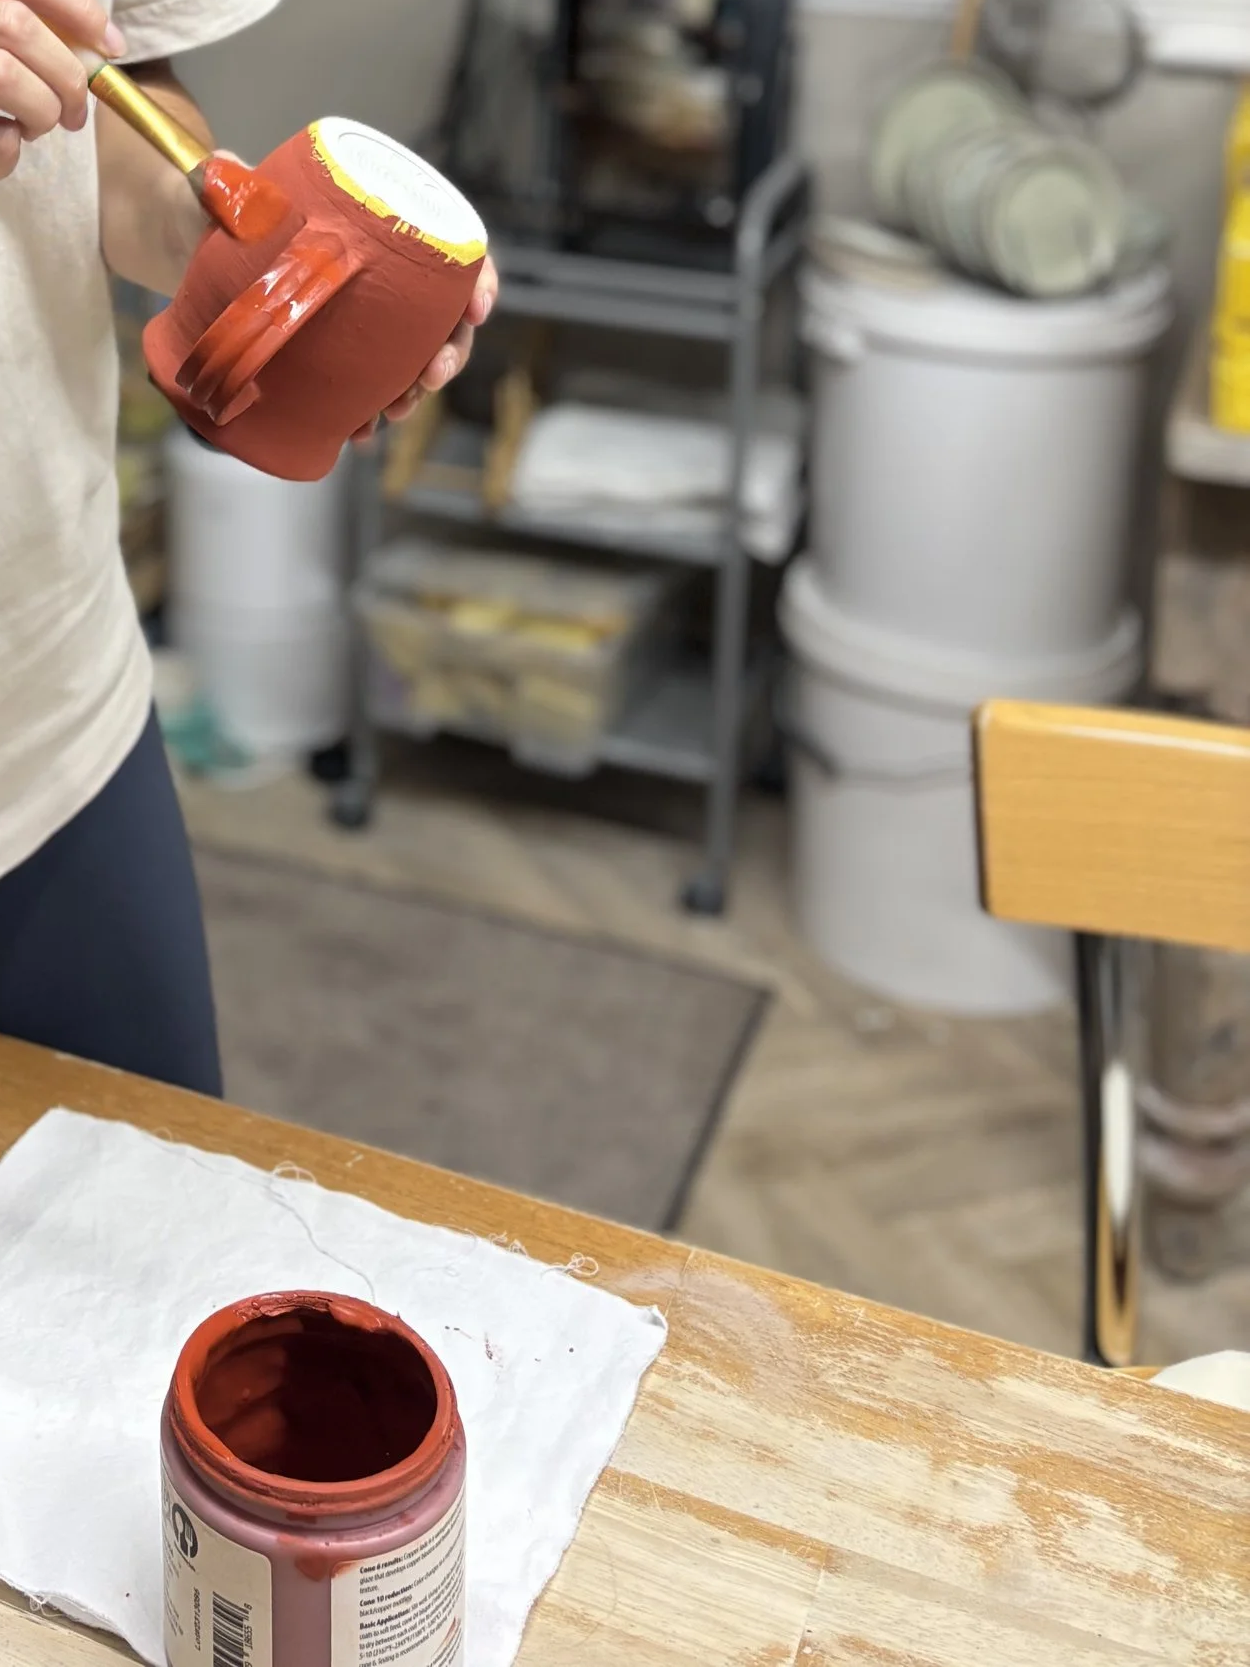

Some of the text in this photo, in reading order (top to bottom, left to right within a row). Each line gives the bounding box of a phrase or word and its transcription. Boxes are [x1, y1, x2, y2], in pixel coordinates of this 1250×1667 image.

[360, 1566, 376, 1574] Cone
[381, 1556, 404, 1570] results:
[374, 1572, 385, 1581] that
[360, 1599, 376, 1607] Cone
[376, 1595, 385, 1603] 10
[385, 1583, 414, 1601] reduction:
[360, 1621, 376, 1630] Basic
[376, 1608, 410, 1626] Application:
[365, 1641, 375, 1650] dry
[375, 1634, 397, 1647] between
